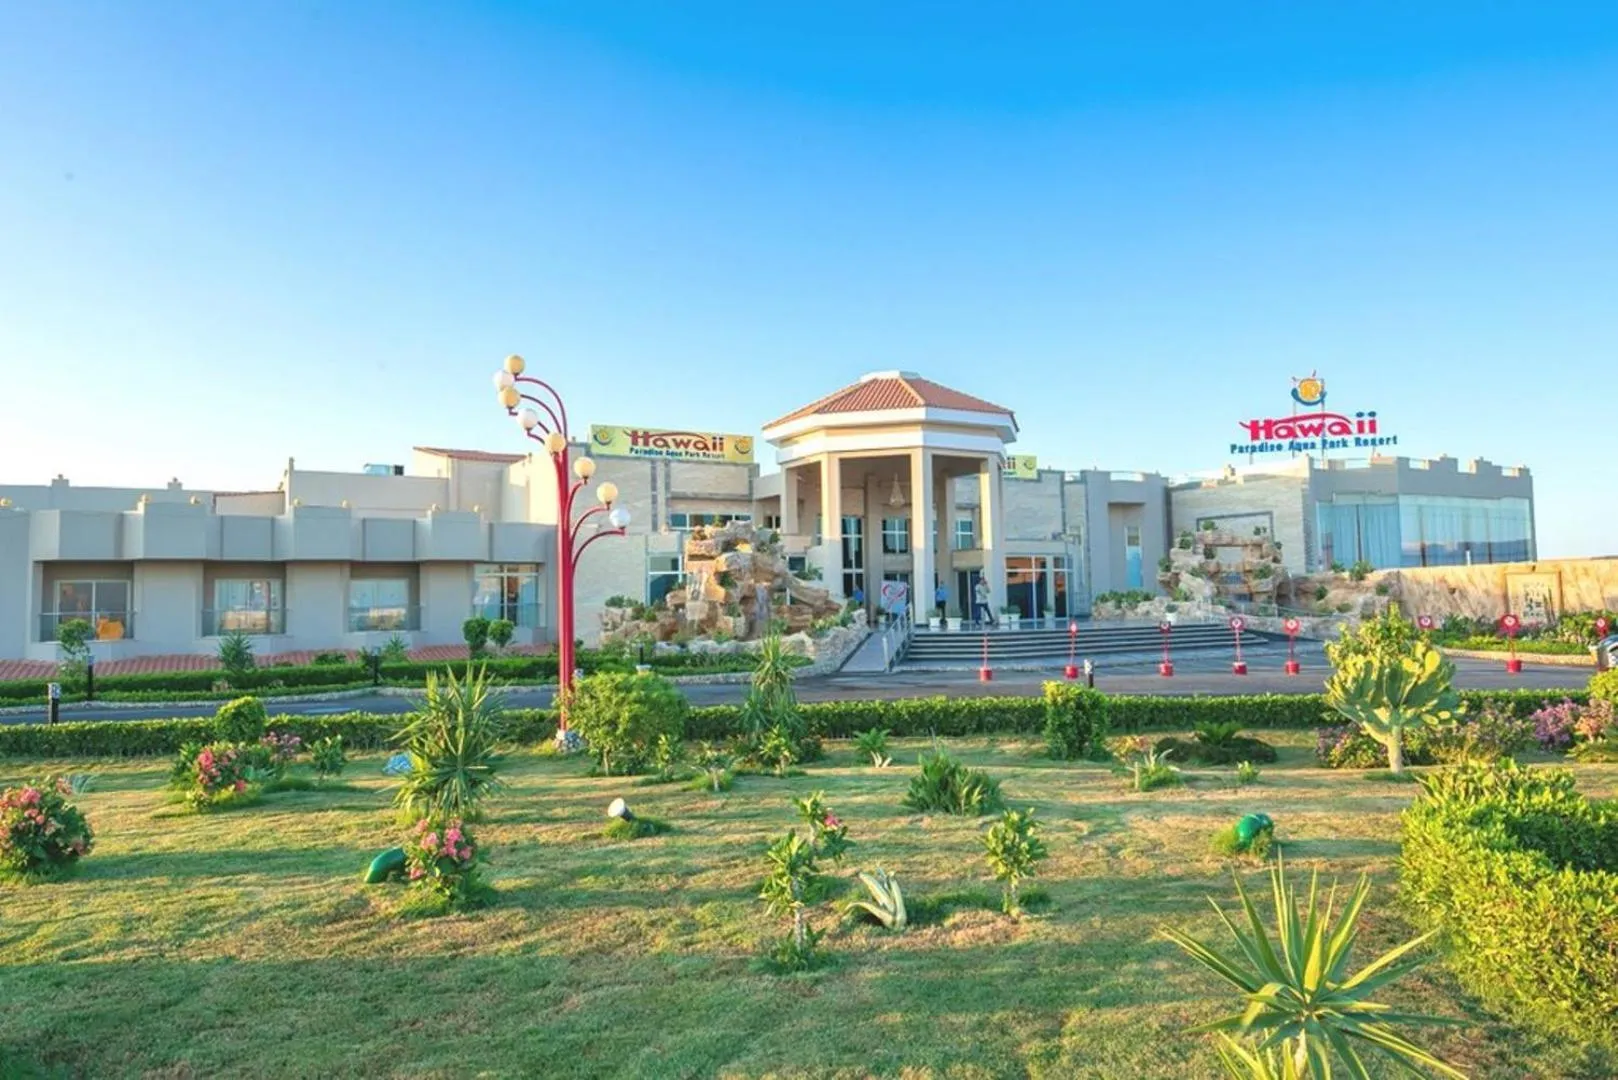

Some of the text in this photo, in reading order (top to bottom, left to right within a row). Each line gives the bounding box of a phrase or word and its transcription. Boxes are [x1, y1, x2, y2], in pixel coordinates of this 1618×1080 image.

[1239, 411, 1377, 441] Hawaii
[624, 429, 724, 452] Hawaii
[1230, 435, 1398, 454] Paradise Aqua Park Resort
[629, 447, 663, 457] Paradise
[685, 451, 700, 459] Park
